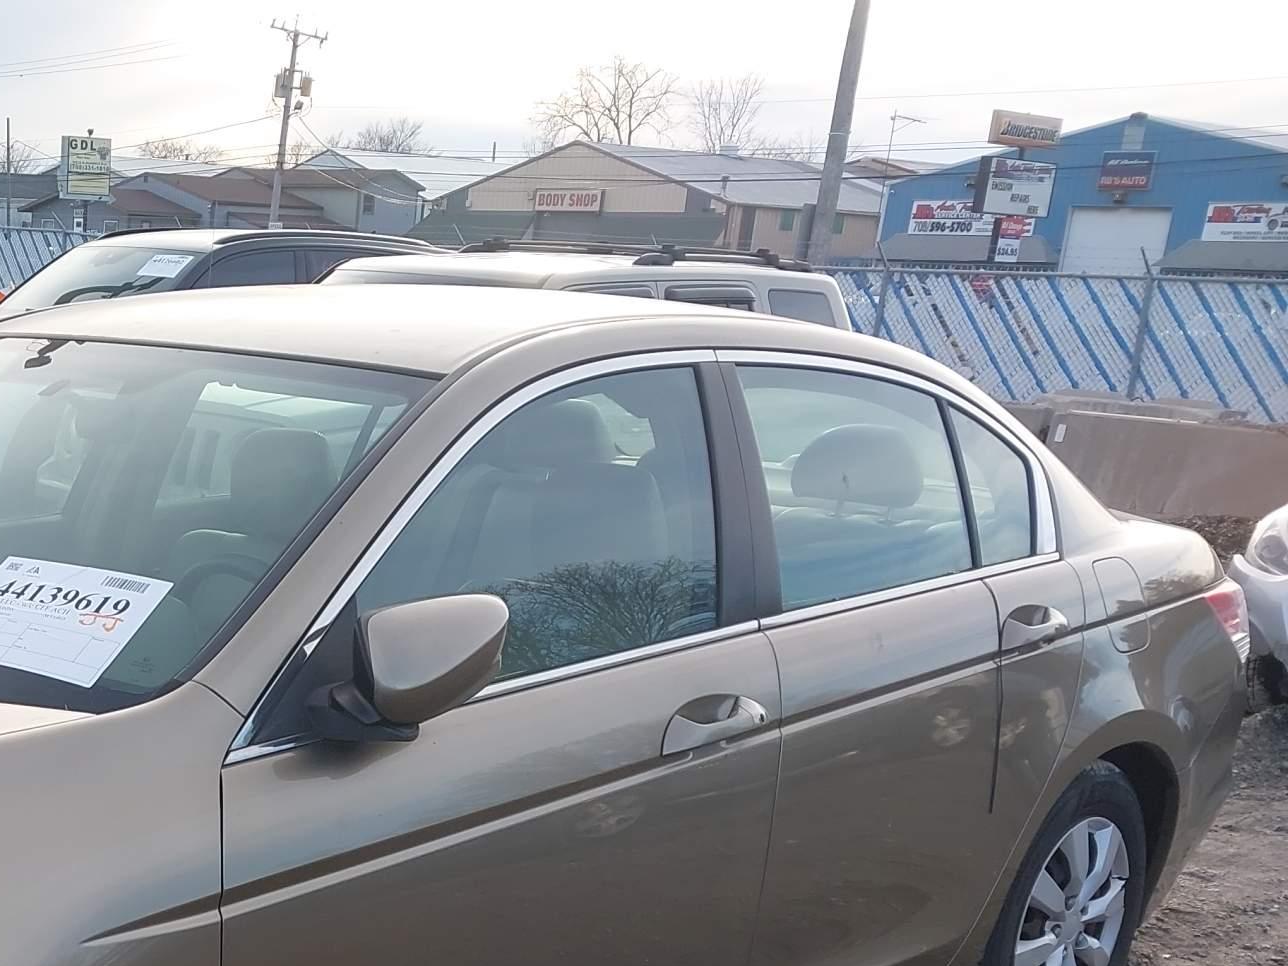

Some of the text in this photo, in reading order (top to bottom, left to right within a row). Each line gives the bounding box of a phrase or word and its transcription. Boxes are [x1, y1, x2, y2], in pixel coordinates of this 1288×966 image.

[70, 138, 97, 151] GDL
[1121, 176, 1146, 185] AUTO
[537, 192, 598, 207] BODY SHOP
